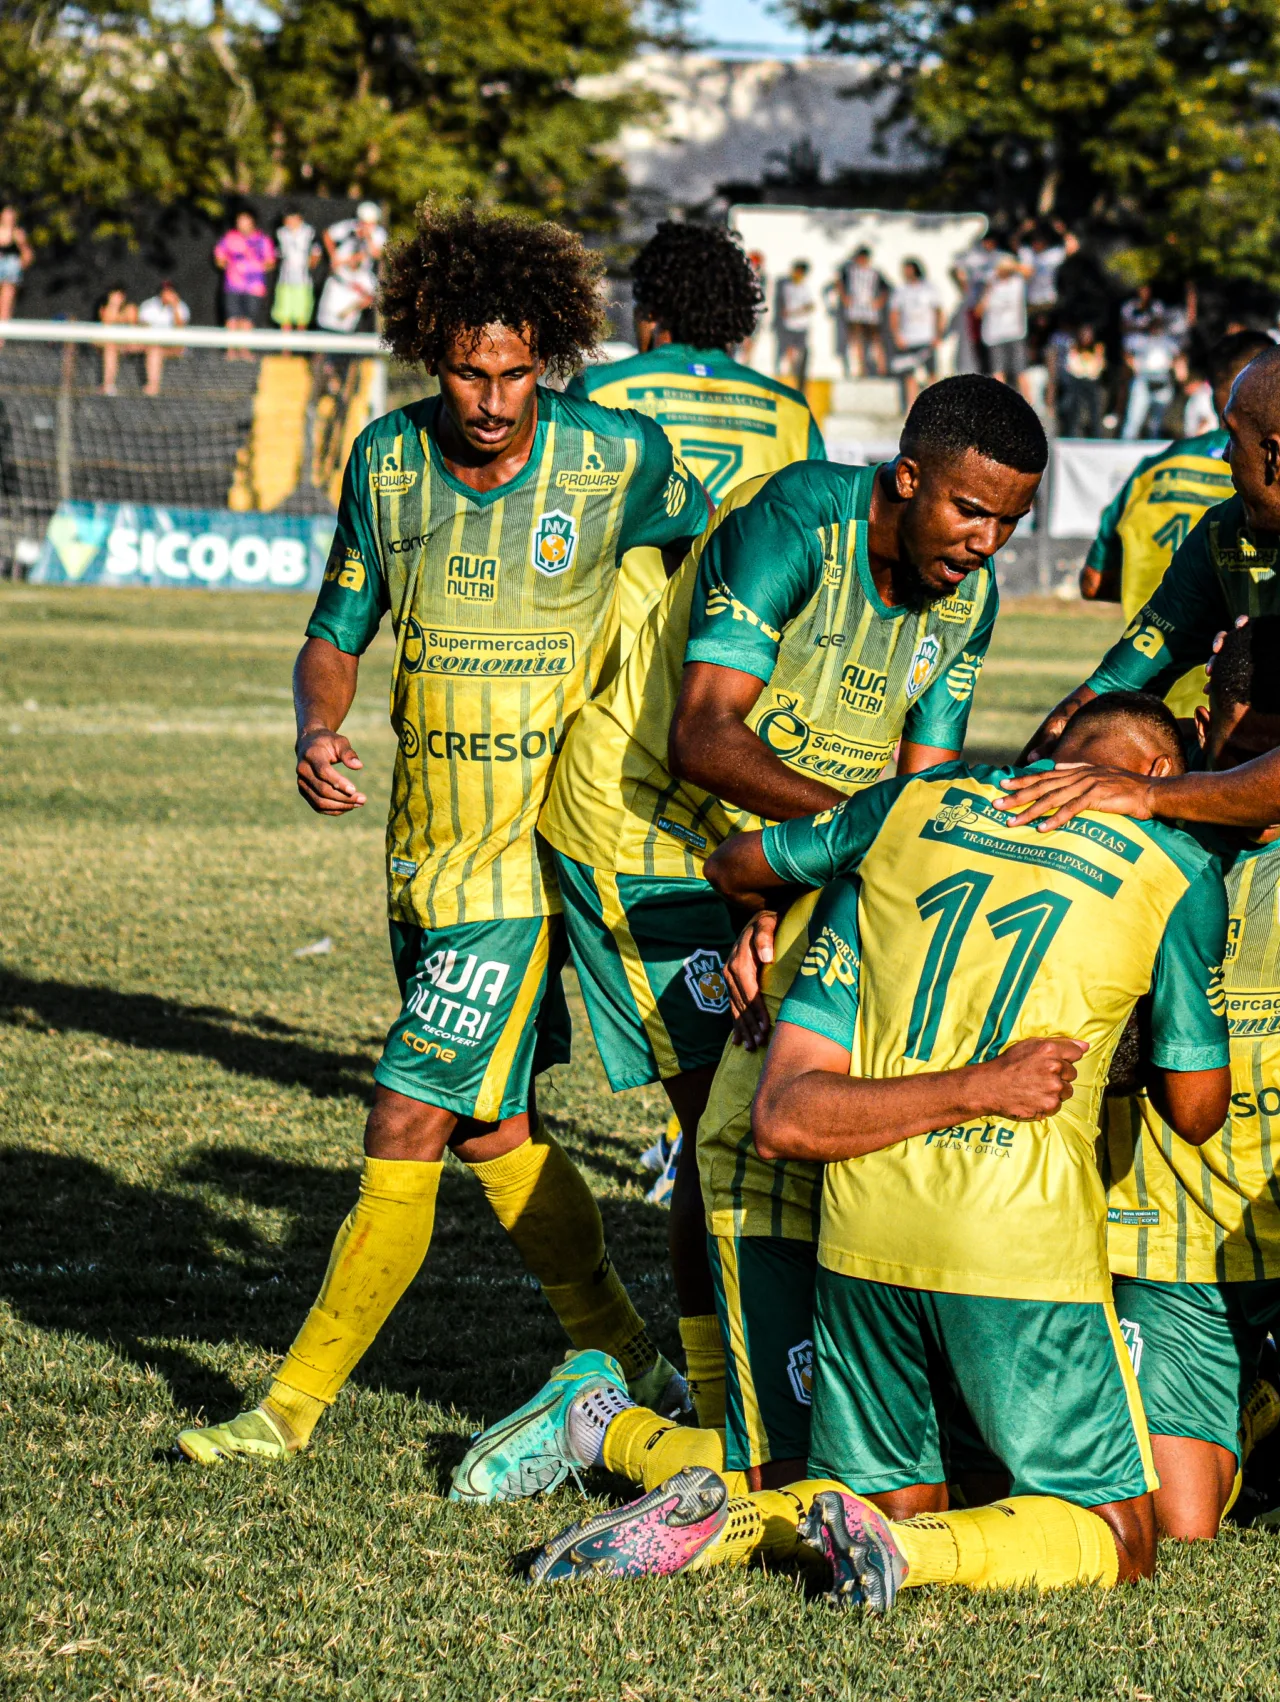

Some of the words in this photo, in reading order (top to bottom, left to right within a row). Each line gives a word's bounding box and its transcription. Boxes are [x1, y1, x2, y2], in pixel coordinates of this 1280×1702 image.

[559, 473, 620, 487] PROWAY
[680, 438, 744, 506] 7
[544, 519, 570, 535] NV
[106, 528, 307, 585] SICOOB
[447, 579, 494, 598] NUTRI
[428, 632, 569, 652] Supermercados
[962, 831, 1047, 858] TRABALHADOR
[1048, 850, 1104, 883] CAPIXABA
[901, 868, 1074, 1066] 11
[406, 982, 492, 1040] NUTRI
[421, 1023, 480, 1048] RECOVERY
